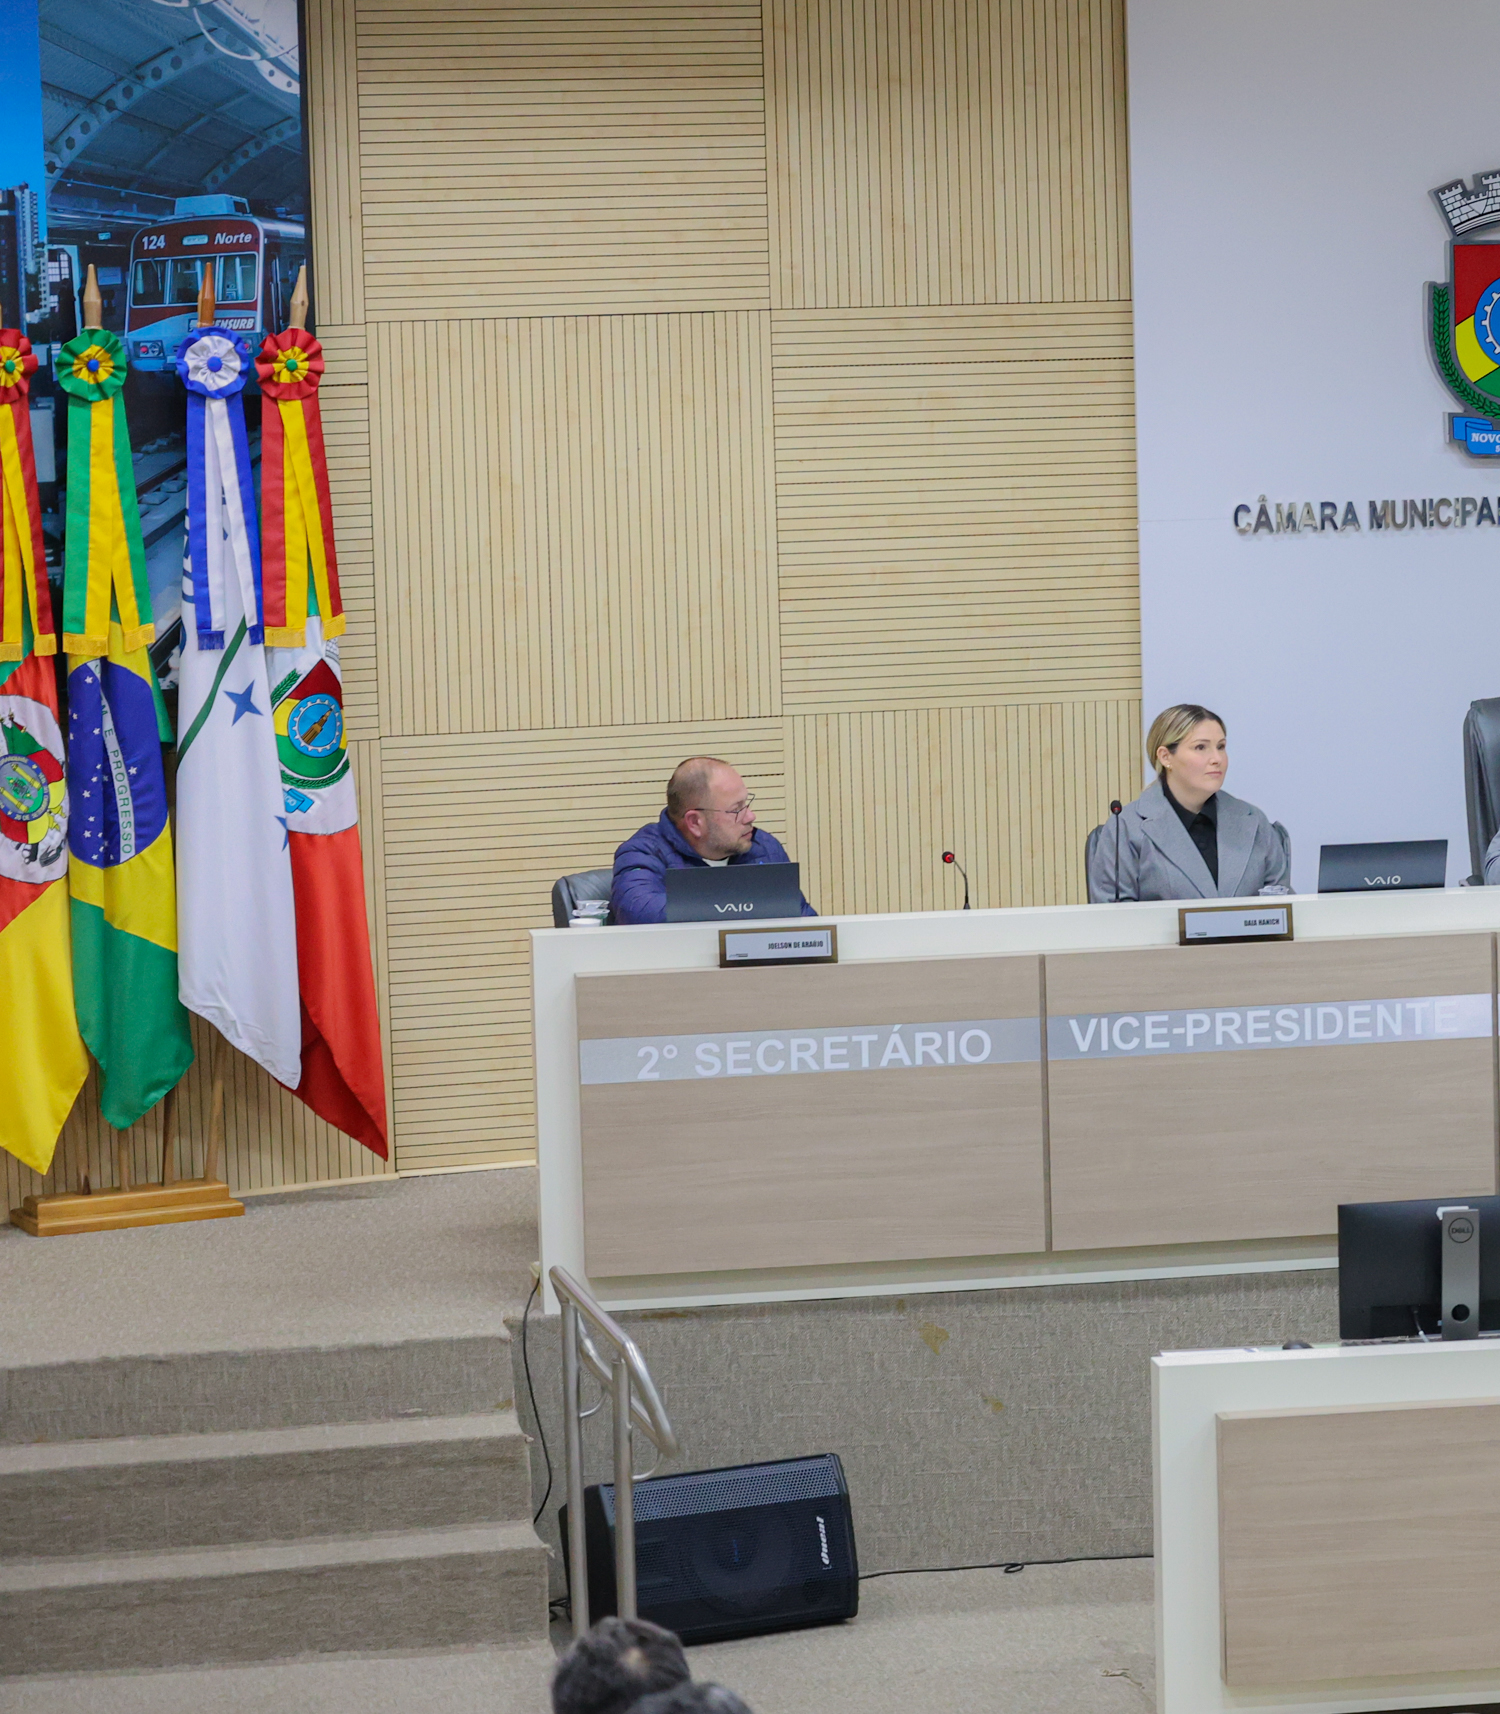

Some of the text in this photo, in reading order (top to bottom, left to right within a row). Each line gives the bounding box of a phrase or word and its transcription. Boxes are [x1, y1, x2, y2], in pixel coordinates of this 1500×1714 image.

[142, 235, 166, 250] 124
[214, 232, 252, 245] Norte
[1495, 445, 1500, 453] 5
[1233, 494, 1361, 534] CÂMARA
[104, 728, 134, 855] E PROGRESSO
[1364, 875, 1401, 886] VAIO
[714, 903, 754, 913] VAIO
[1243, 918, 1280, 927] DAIA HANICH
[768, 941, 792, 950] JOELSON
[793, 941, 801, 949] DE
[1069, 1000, 1459, 1053] VICE-PRESIDENTE
[694, 1023, 992, 1078] SECRETÁRIO
